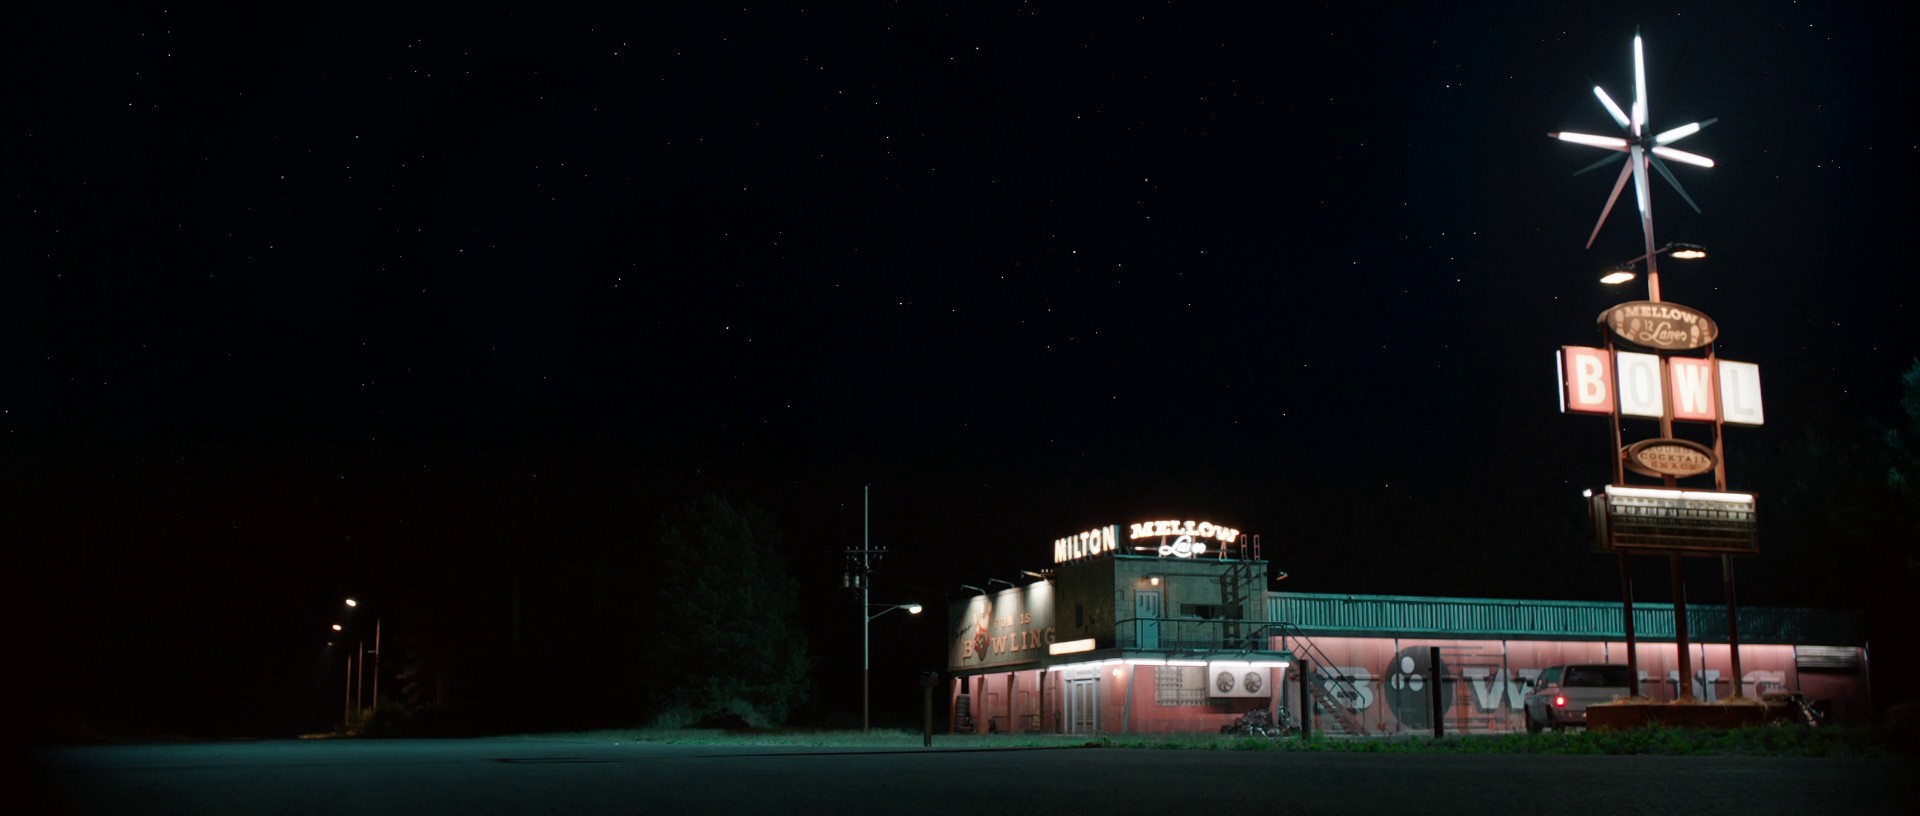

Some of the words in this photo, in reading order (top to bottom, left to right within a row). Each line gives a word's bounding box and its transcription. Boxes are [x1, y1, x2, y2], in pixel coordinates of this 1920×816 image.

[1625, 306, 1698, 324] MELLOW
[1644, 319, 1655, 332] 12
[1638, 321, 1688, 346] Lanes
[1575, 354, 1755, 416] BOWL
[1640, 452, 1708, 464] COCKTAIL
[1130, 519, 1240, 544] MELLOW
[1054, 524, 1116, 564] MILTON
[1020, 612, 1032, 626] IS
